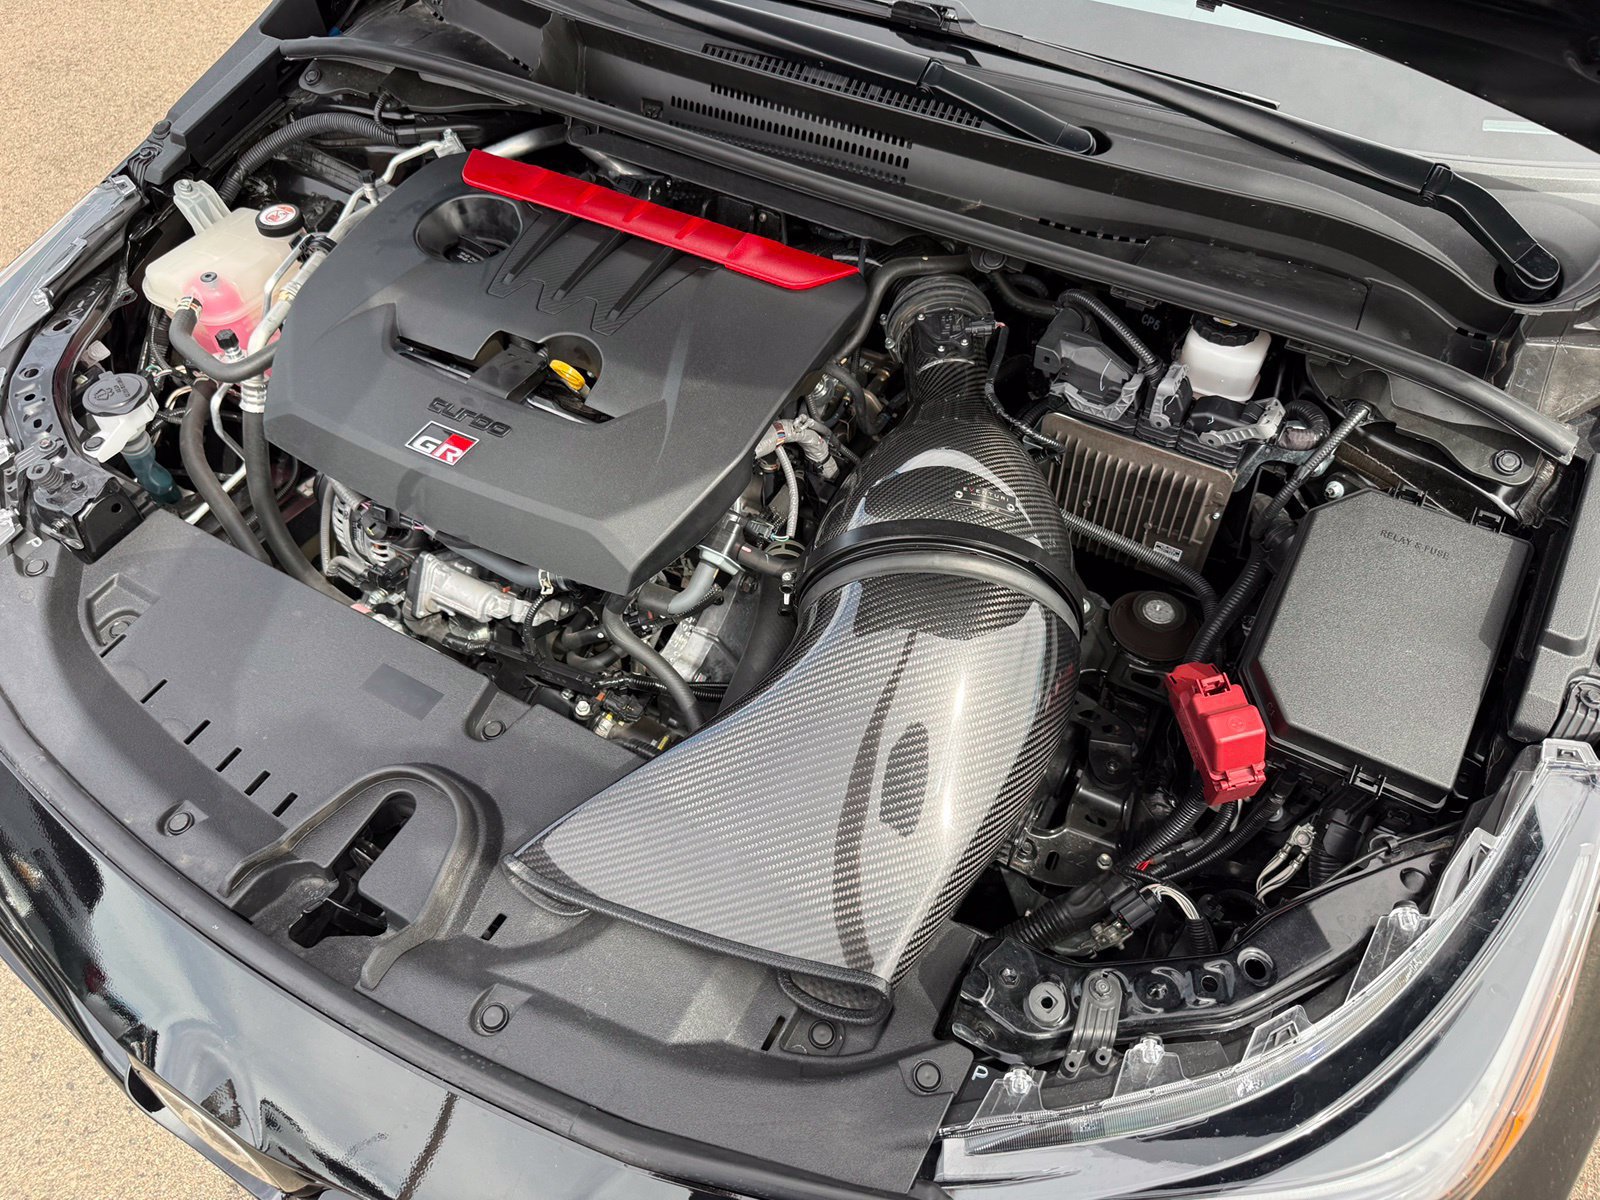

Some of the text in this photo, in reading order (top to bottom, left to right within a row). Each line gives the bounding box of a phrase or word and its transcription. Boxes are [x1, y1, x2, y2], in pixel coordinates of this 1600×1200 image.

[1380, 529, 1413, 546] RELAY
[1423, 544, 1450, 561] FUSE
[971, 1065, 989, 1081] P
